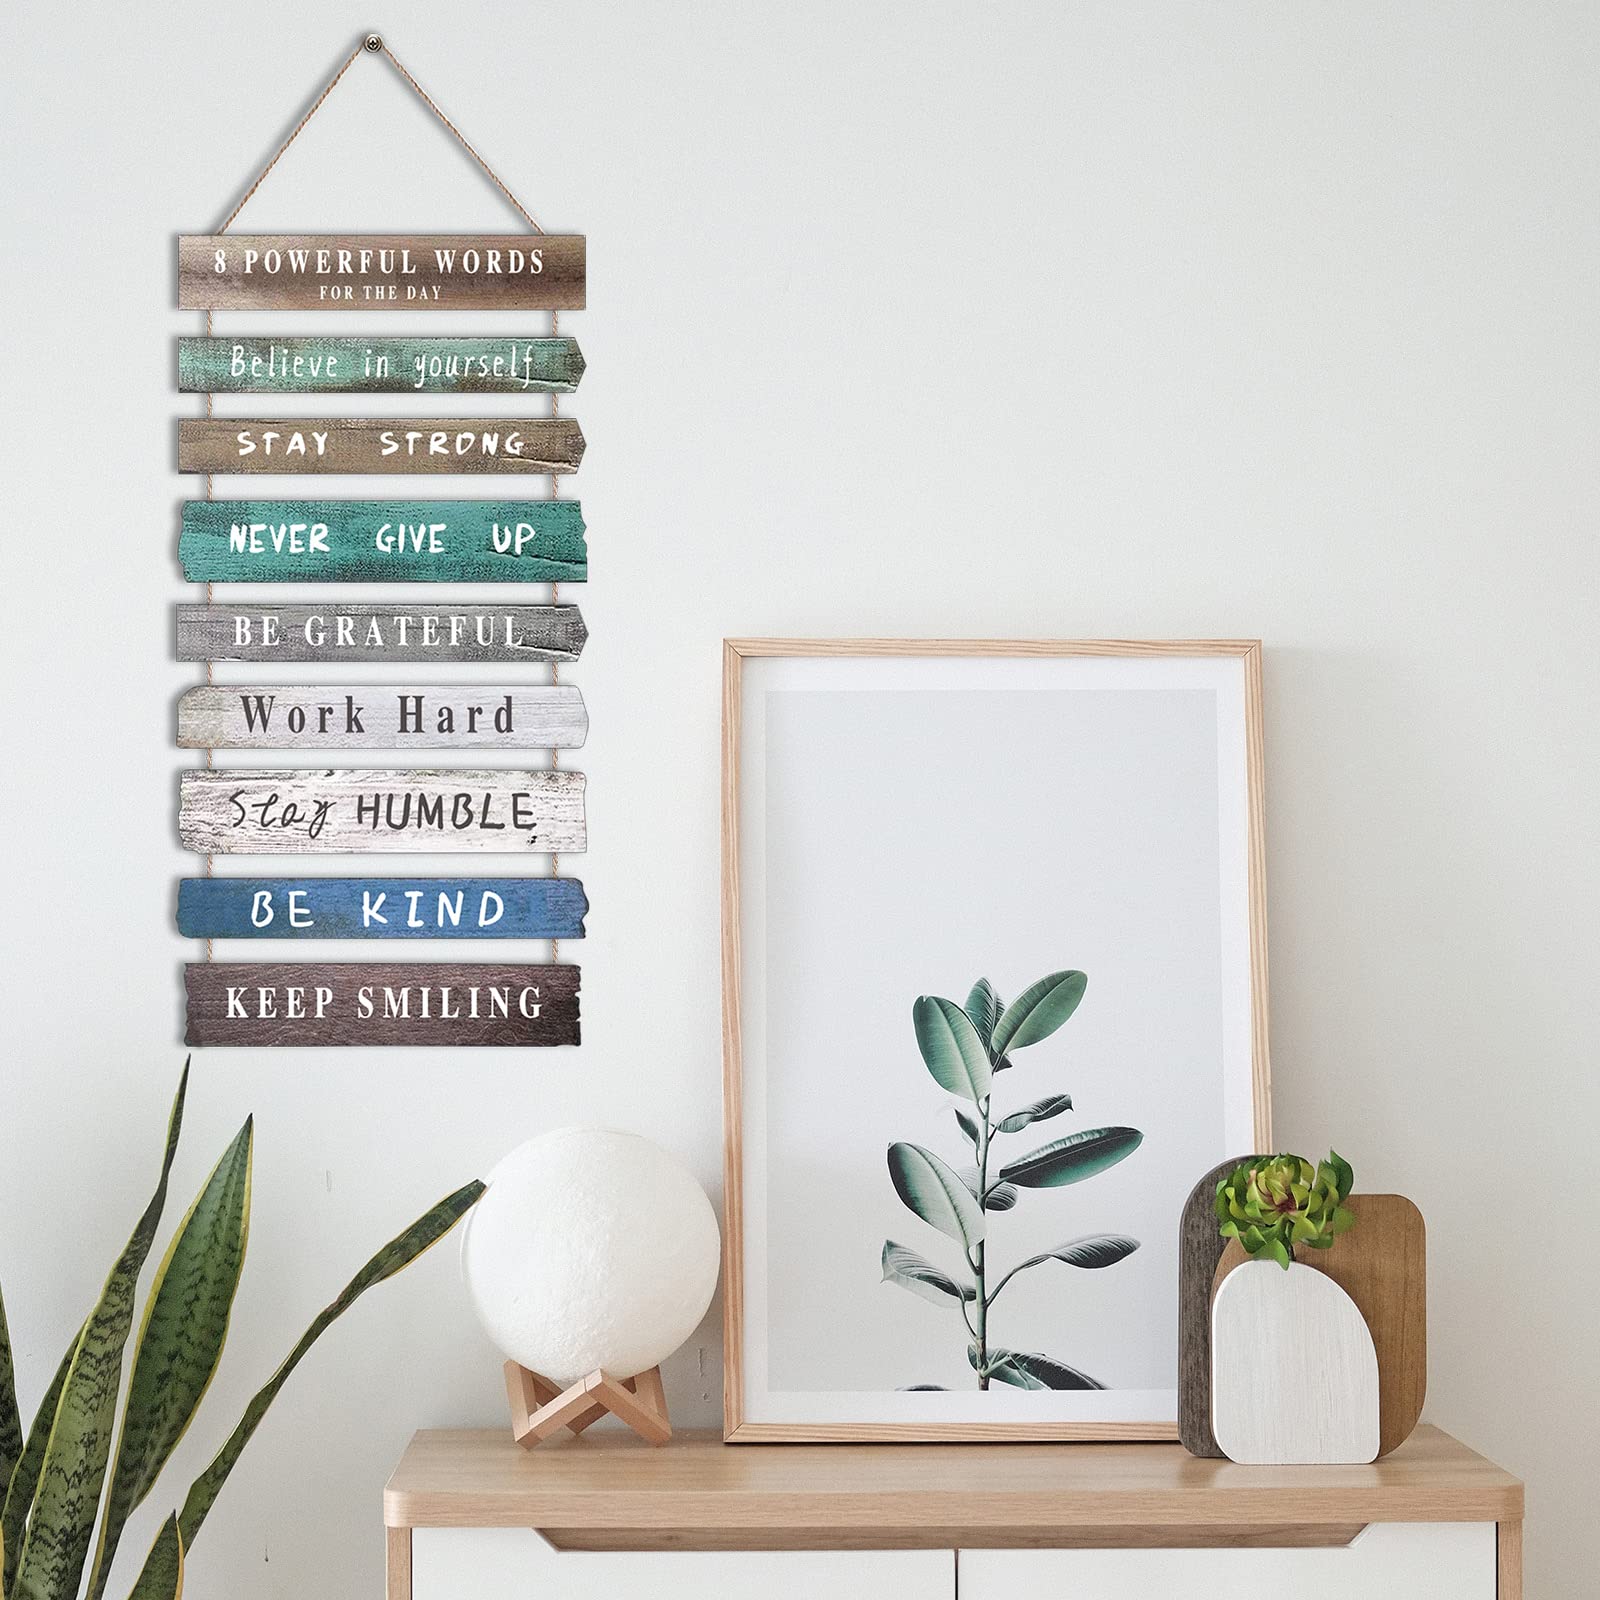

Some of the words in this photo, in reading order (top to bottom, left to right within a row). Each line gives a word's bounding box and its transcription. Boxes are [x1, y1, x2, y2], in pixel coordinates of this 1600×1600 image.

[214, 249, 227, 274] 8
[244, 249, 417, 275] POWERFUL
[435, 249, 545, 275] WORDS
[320, 285, 354, 300] FOR
[363, 285, 398, 300] THE
[407, 285, 442, 300] DAY
[230, 345, 338, 377] Believe
[365, 349, 388, 377] in
[414, 345, 533, 389] yourself
[237, 431, 329, 456] STAY
[380, 431, 525, 457] STRONG
[229, 523, 330, 553] NEVER
[375, 523, 446, 553] GIVE
[492, 523, 536, 553] UP
[234, 615, 279, 647] BE
[305, 615, 524, 647] GRATEFUL
[240, 695, 365, 734] Work
[397, 695, 514, 734] Hard
[229, 790, 336, 839] Stay
[357, 792, 537, 830] HUMBLE
[251, 890, 314, 928] BE
[362, 890, 504, 928] KIND
[225, 986, 333, 1019] KEEP
[358, 986, 543, 1019] SMILING
